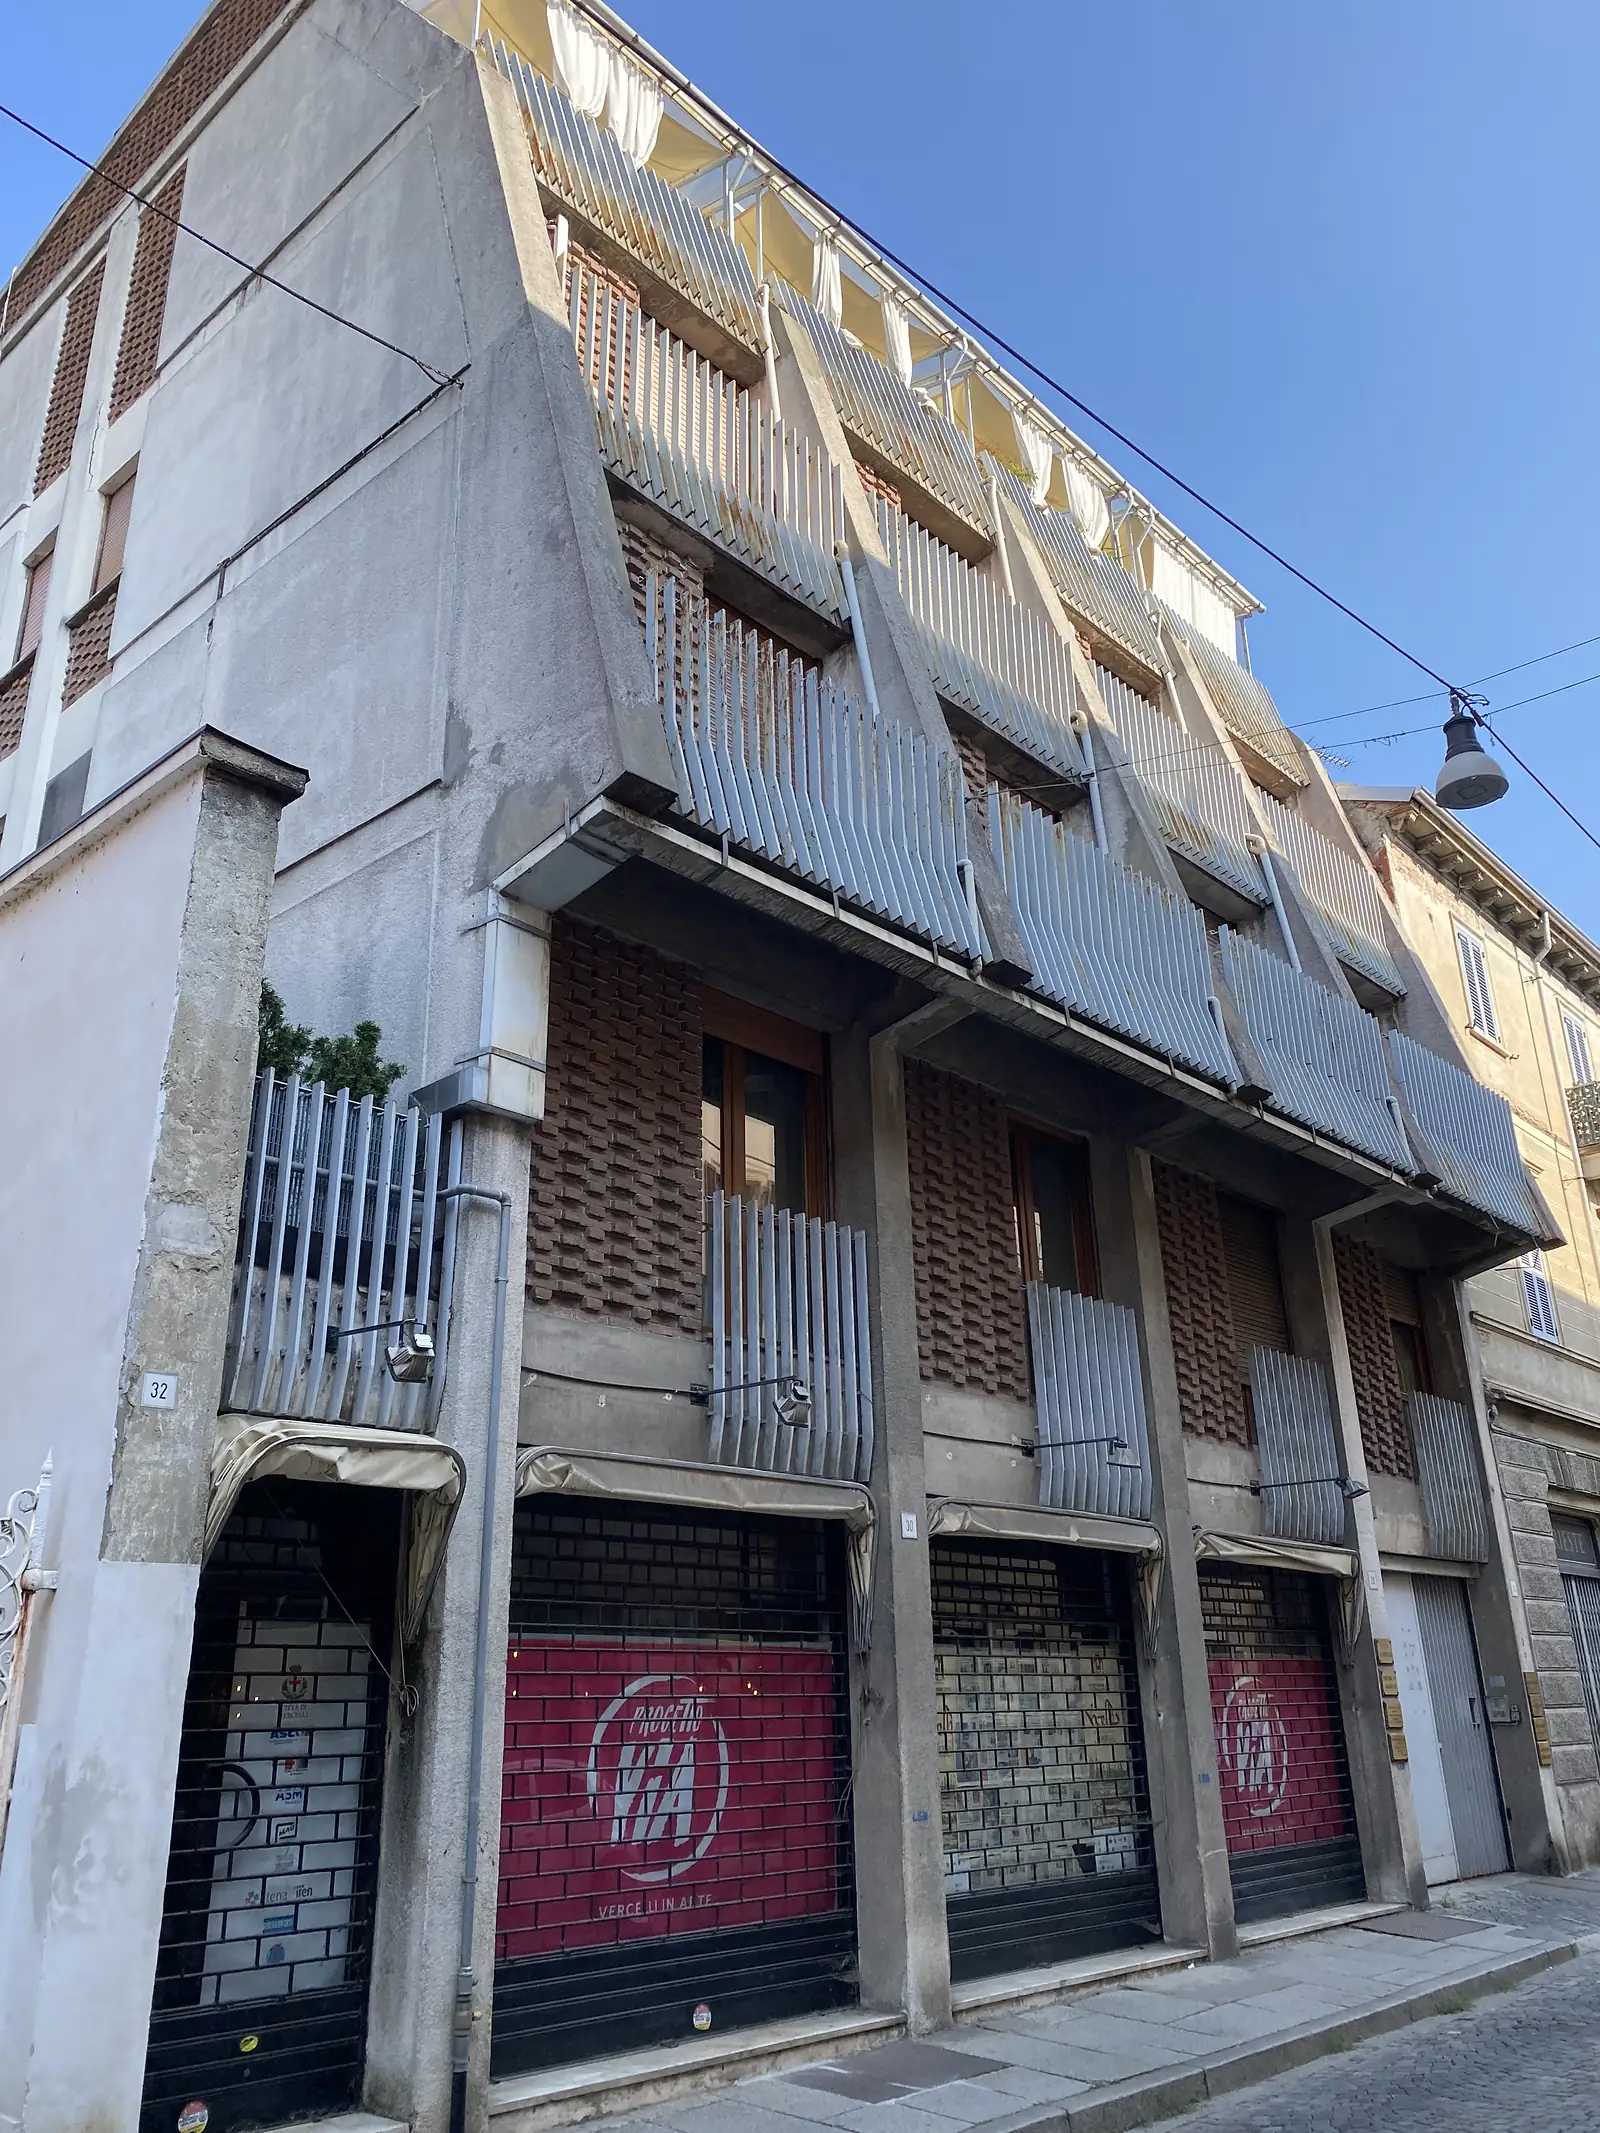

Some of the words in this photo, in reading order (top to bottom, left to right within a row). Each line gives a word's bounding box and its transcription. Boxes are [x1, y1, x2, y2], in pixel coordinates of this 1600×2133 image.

[150, 1381, 168, 1400] 32
[629, 1698, 716, 1738] PROGETTO
[1236, 1720, 1275, 1794] VIA
[610, 1736, 698, 1848] VIA
[265, 1889, 288, 1904] tena
[295, 1886, 313, 1899] iren
[598, 1899, 659, 1920] VERCELI
